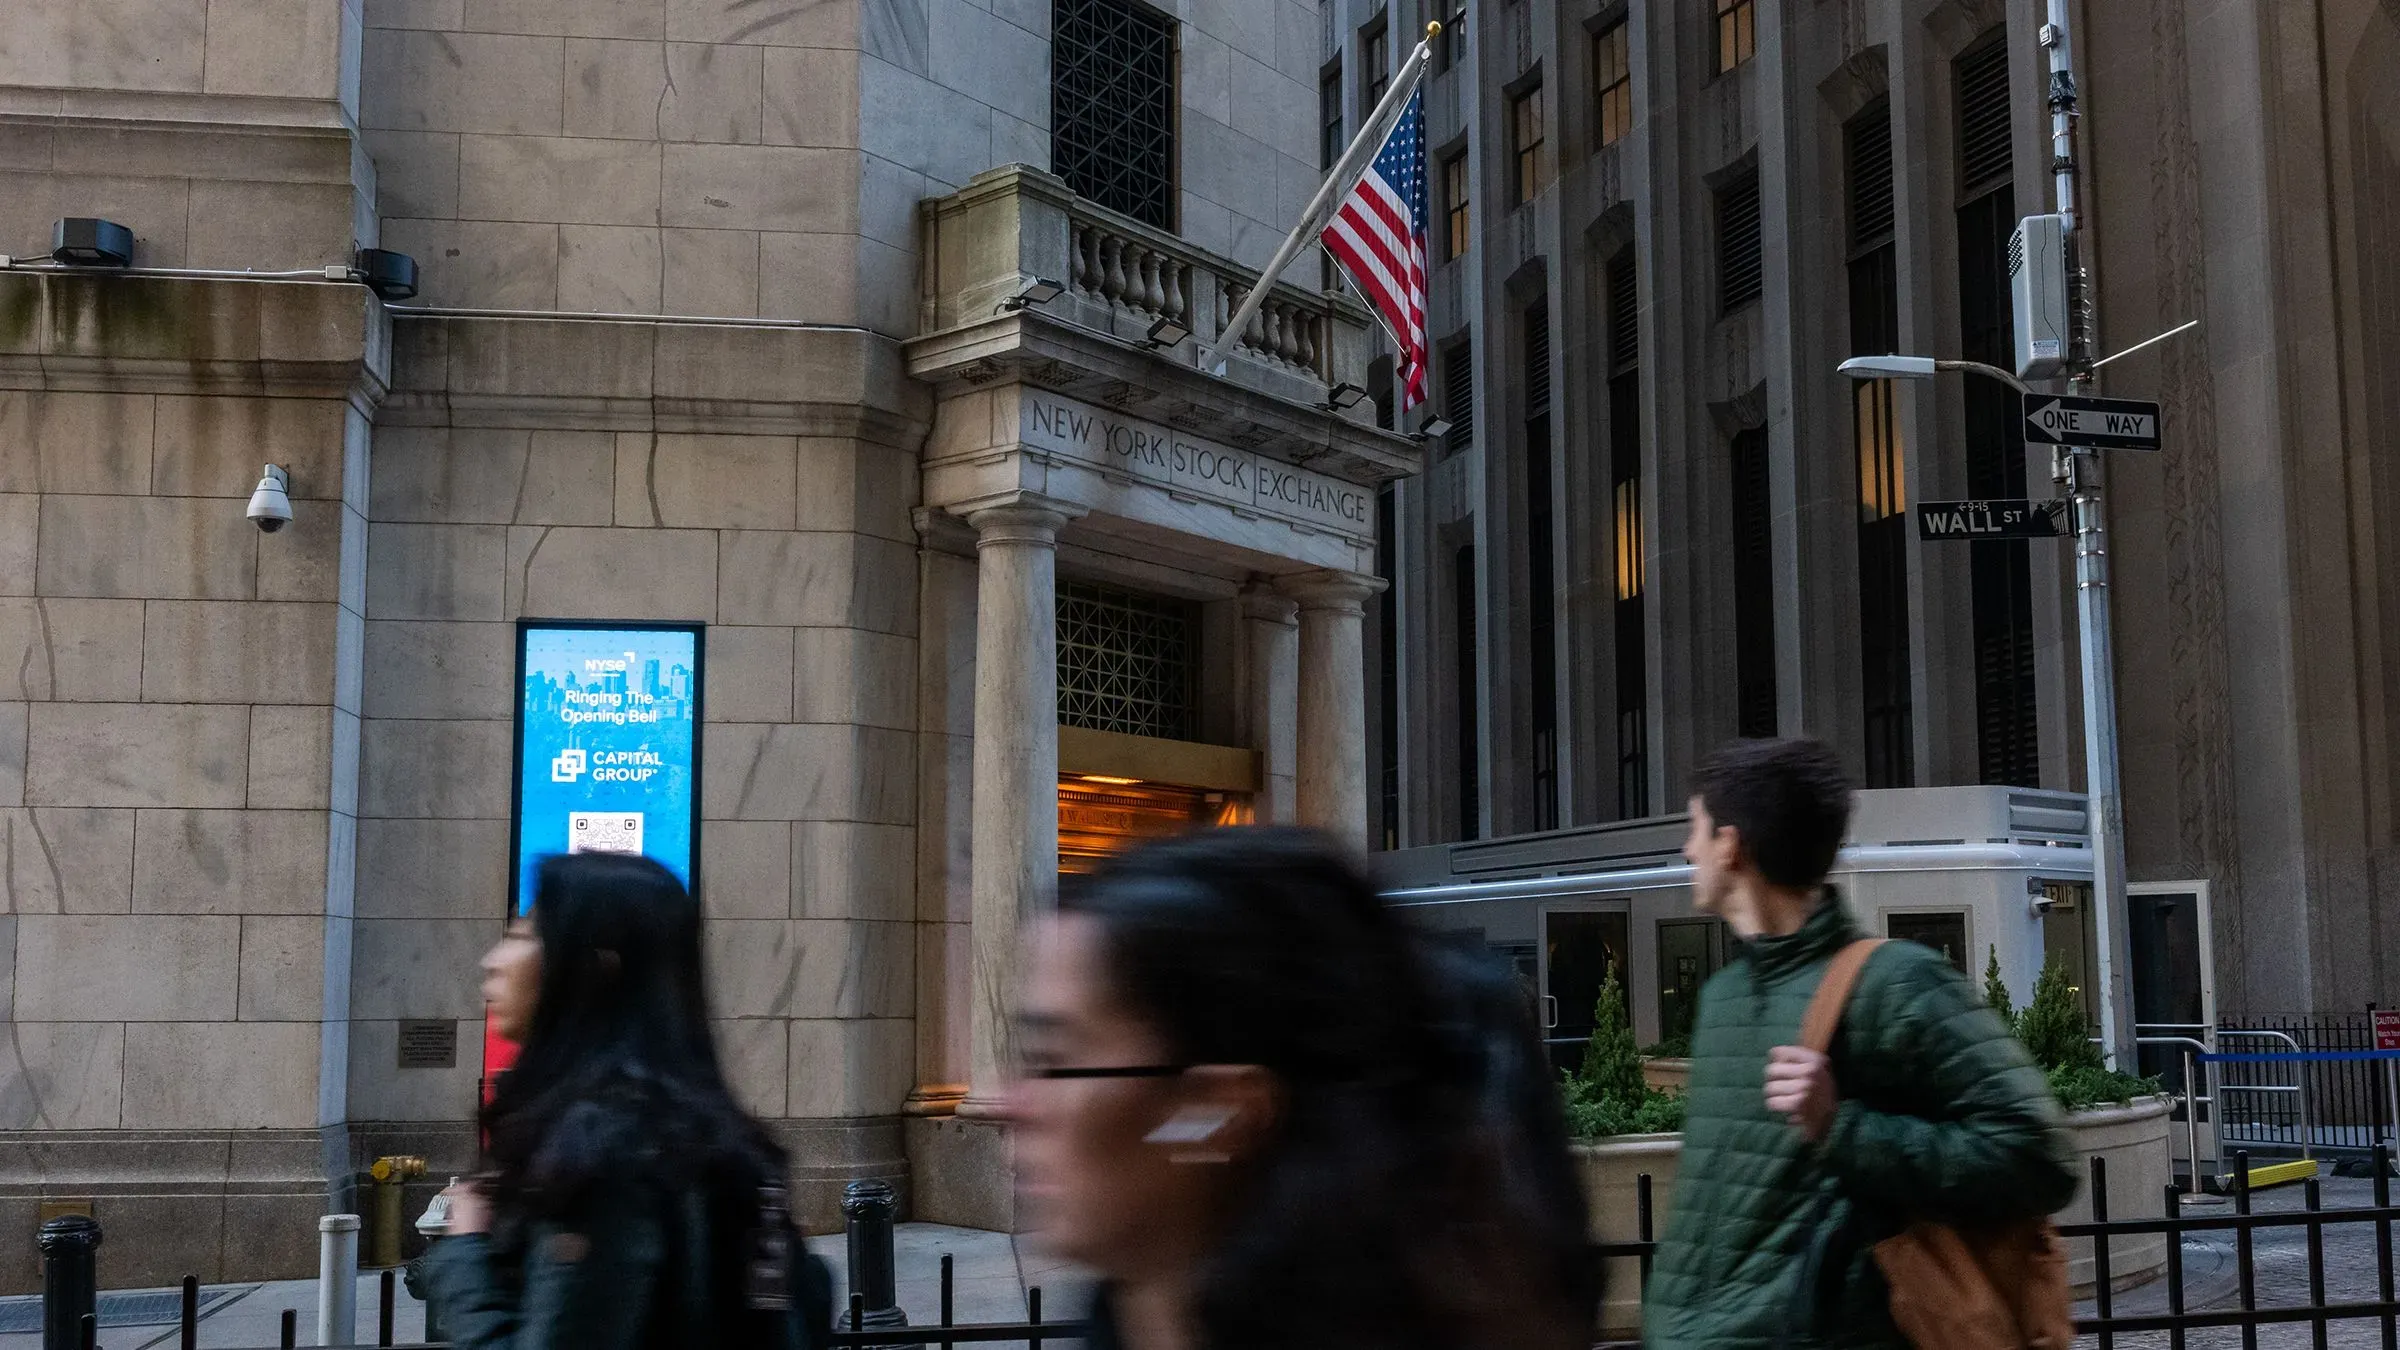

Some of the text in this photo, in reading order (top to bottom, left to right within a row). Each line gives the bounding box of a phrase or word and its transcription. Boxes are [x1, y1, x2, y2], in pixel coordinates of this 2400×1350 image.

[2043, 410, 2145, 435] ONE WAY
[1032, 399, 1366, 523] NEW YORK STOCK EXCHANGE
[1967, 502, 1989, 512] 9-15
[1924, 510, 2023, 534] WALL ST
[565, 690, 654, 707] Ringing The
[560, 708, 657, 726] Opening Bell
[592, 751, 663, 766] CAPITAL
[2376, 1016, 2400, 1025] CAUTION
